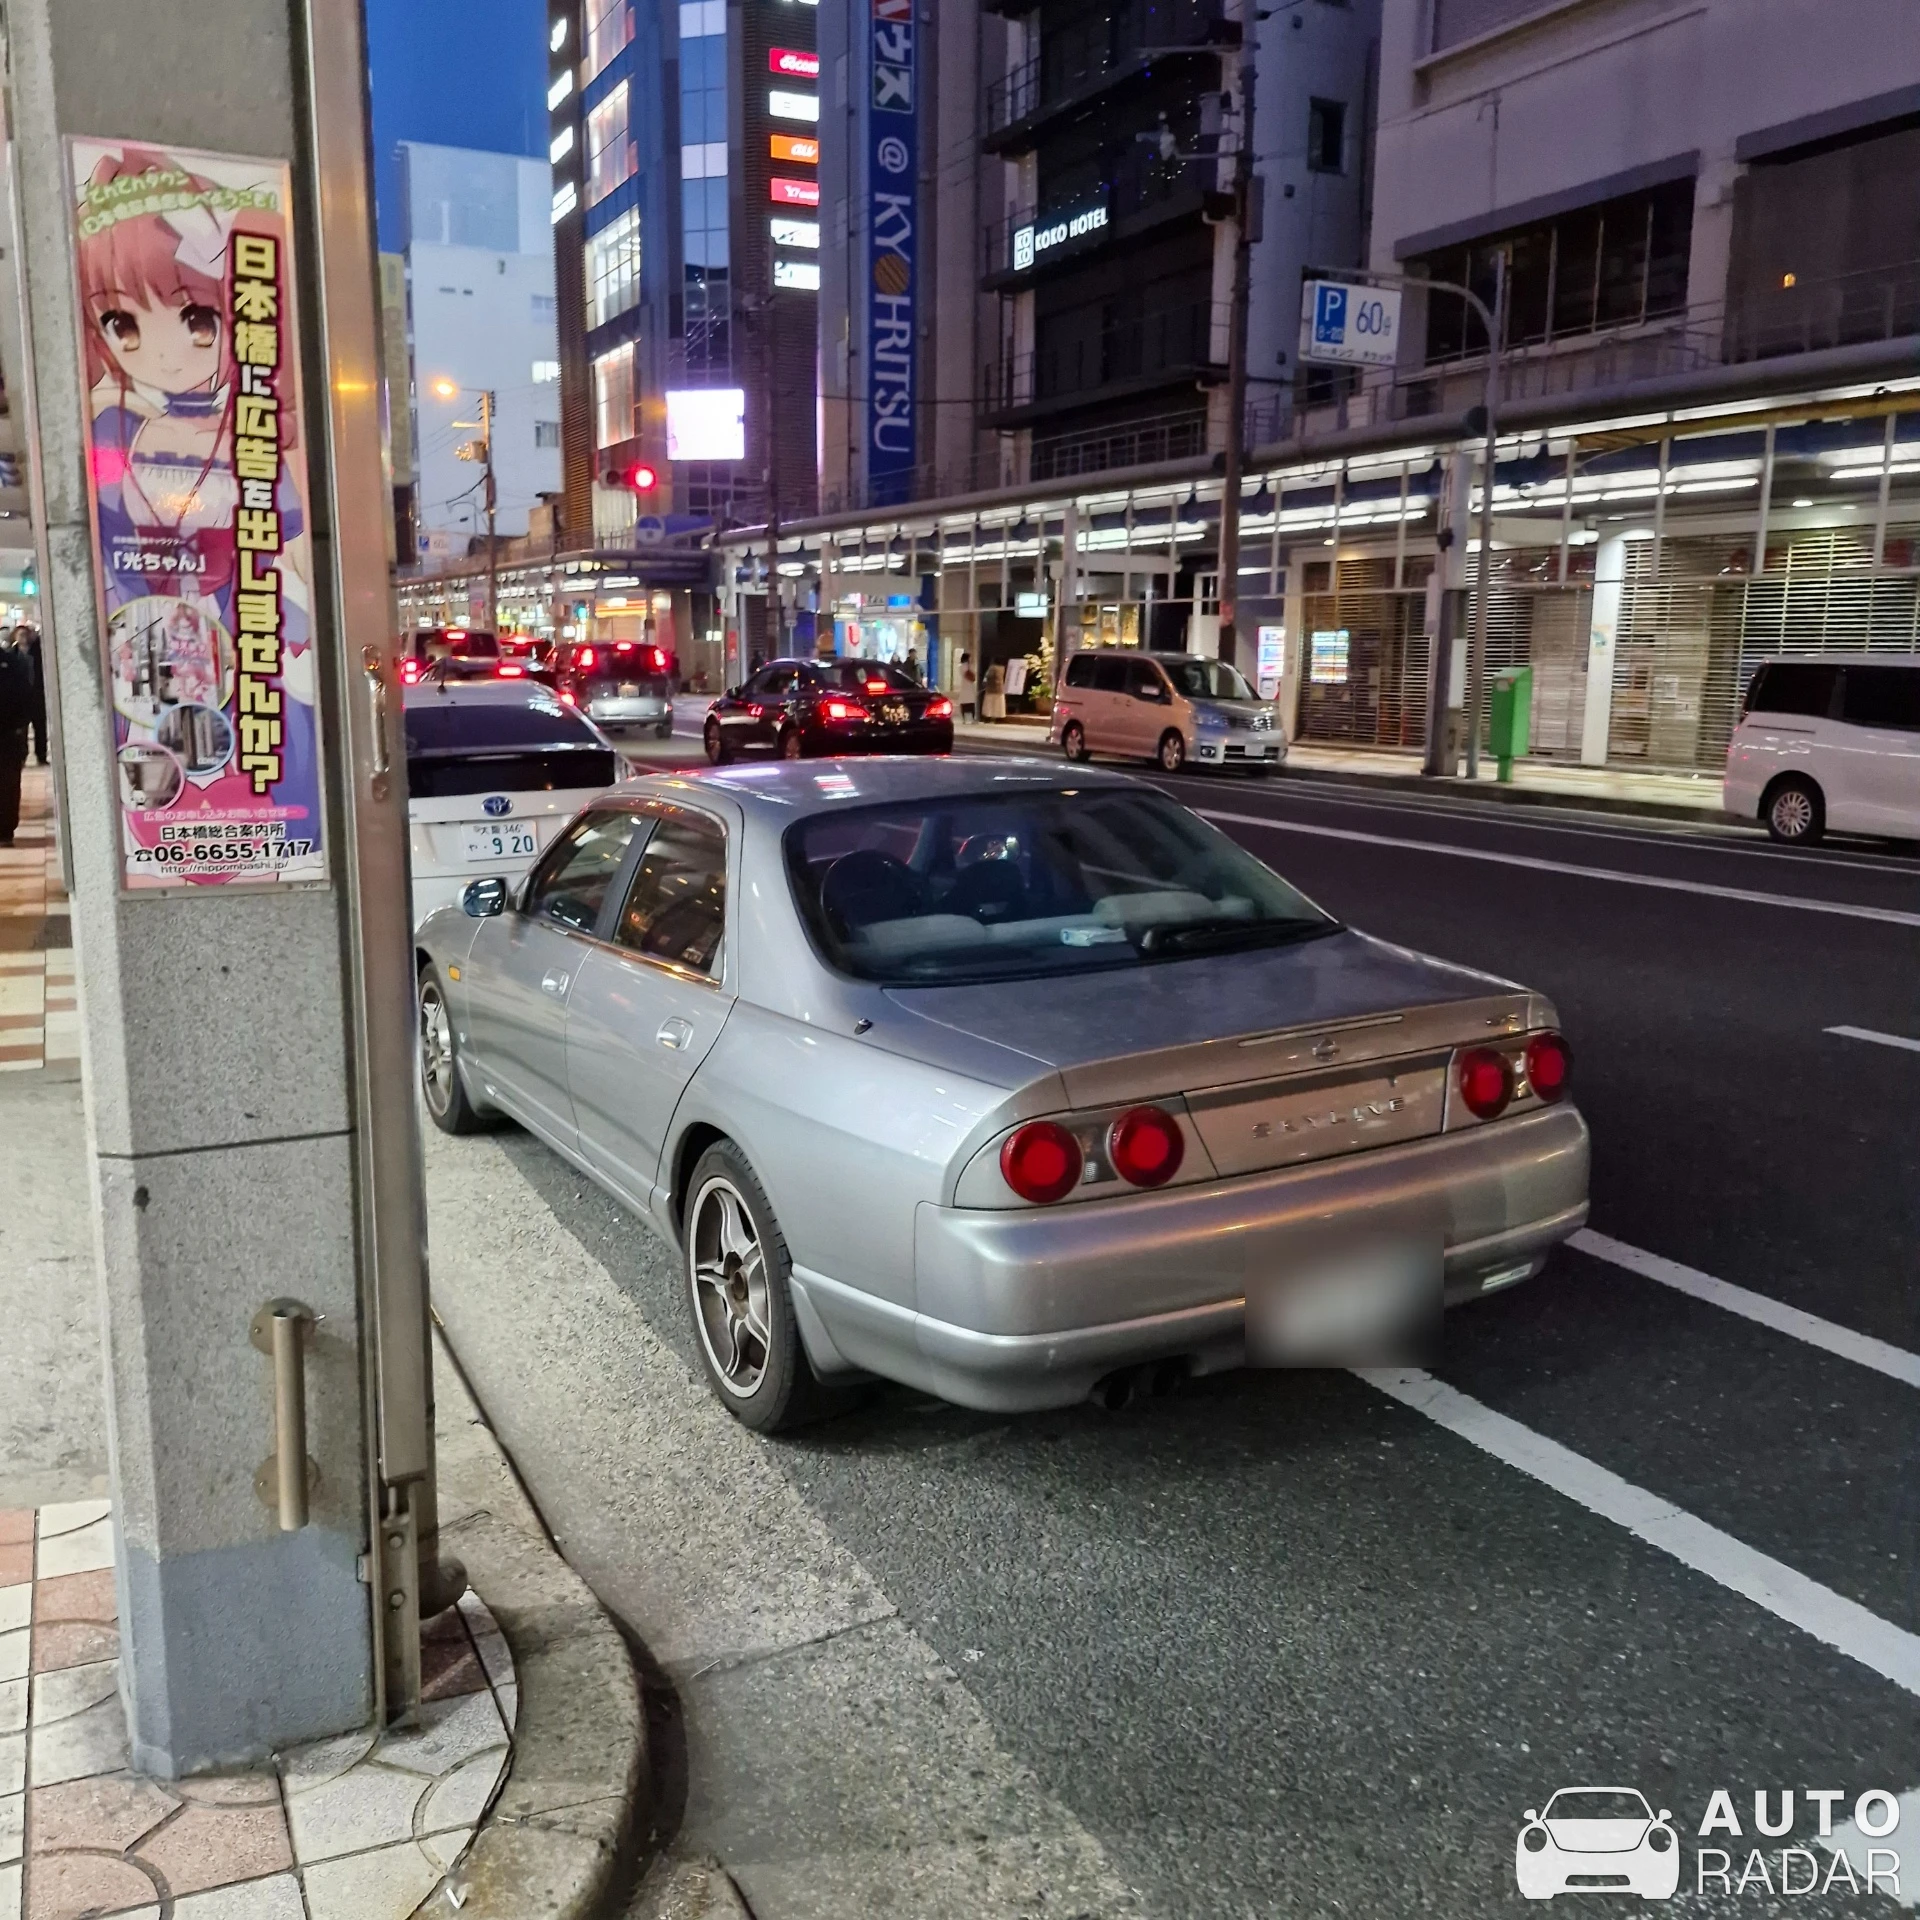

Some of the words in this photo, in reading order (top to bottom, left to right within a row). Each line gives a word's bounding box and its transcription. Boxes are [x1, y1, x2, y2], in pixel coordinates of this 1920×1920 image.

[791, 143, 817, 158] au
[1035, 223, 1068, 252] KOKO
[1069, 206, 1109, 238] HOTEL
[1325, 290, 1342, 322] P
[234, 236, 282, 794] 日本橋に広告を出しませんか?
[161, 823, 286, 841] 日本橋総合案内所
[154, 840, 312, 863] 06-6655-1717
